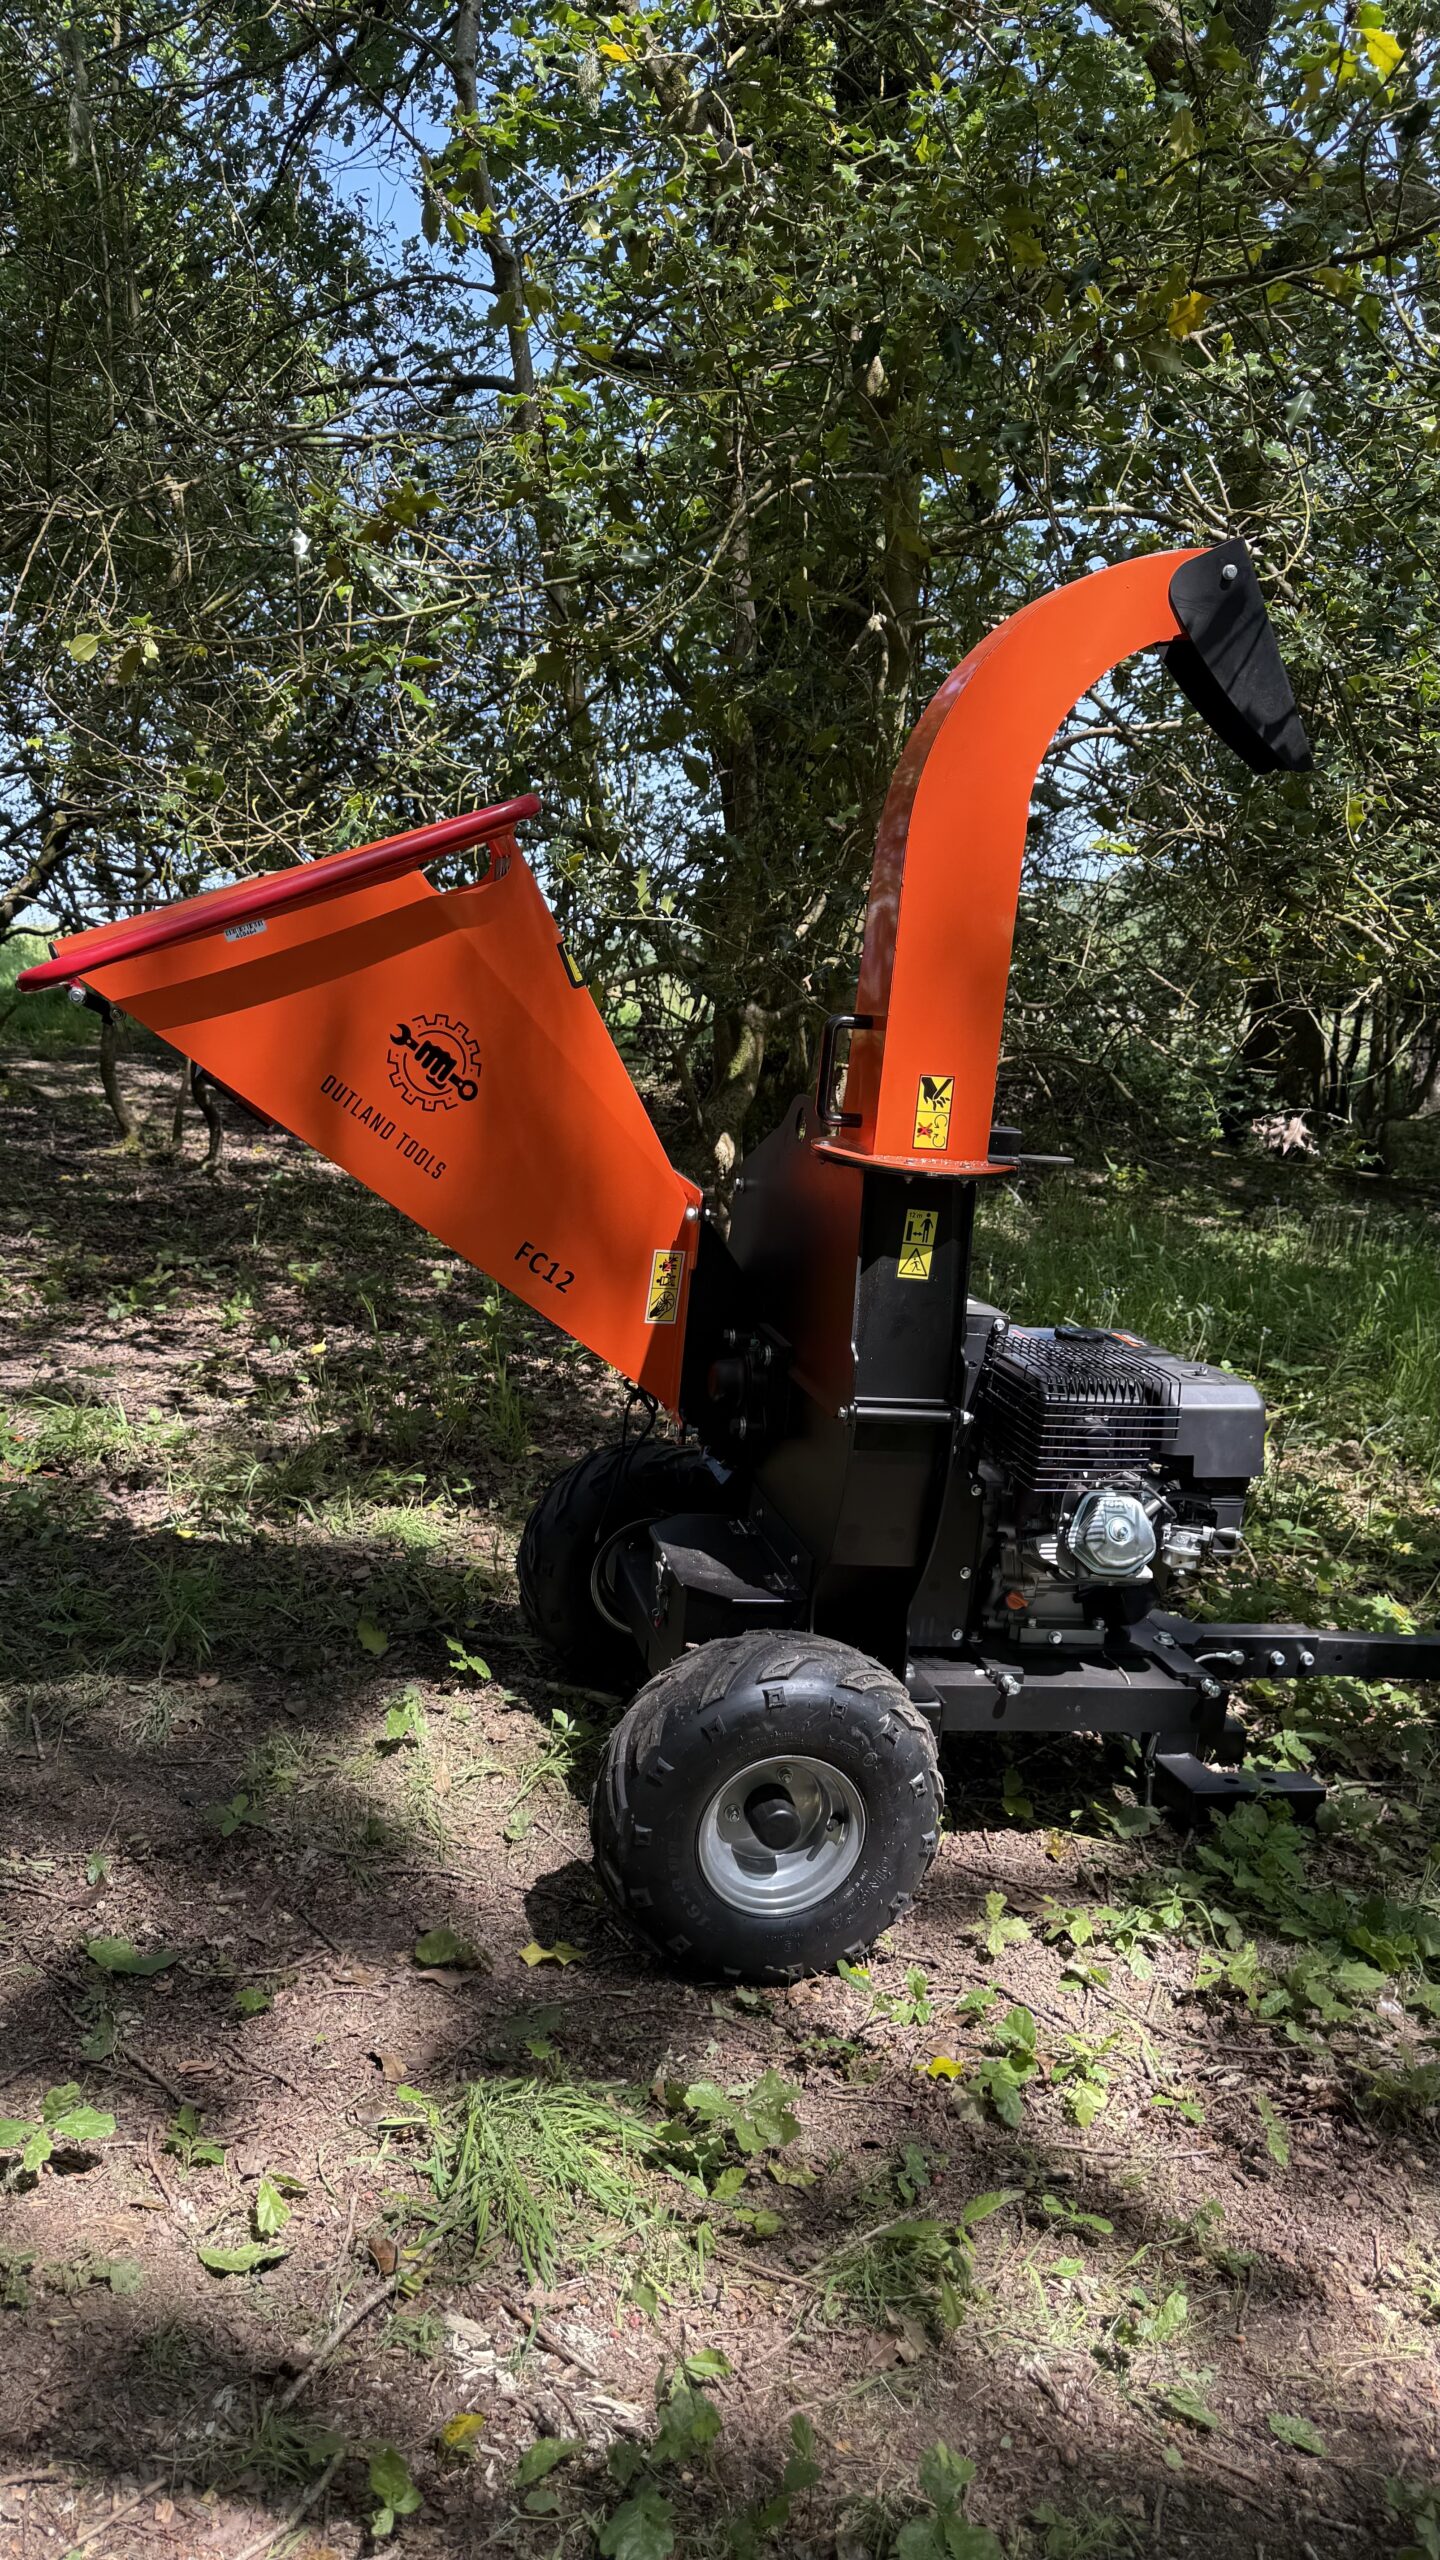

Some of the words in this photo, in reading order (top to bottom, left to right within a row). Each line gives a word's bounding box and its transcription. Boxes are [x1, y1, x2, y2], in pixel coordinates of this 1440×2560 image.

[320, 1074, 396, 1140] OUTLAND
[395, 1131, 447, 1179] TOOLS
[514, 1241, 575, 1294] FC12
